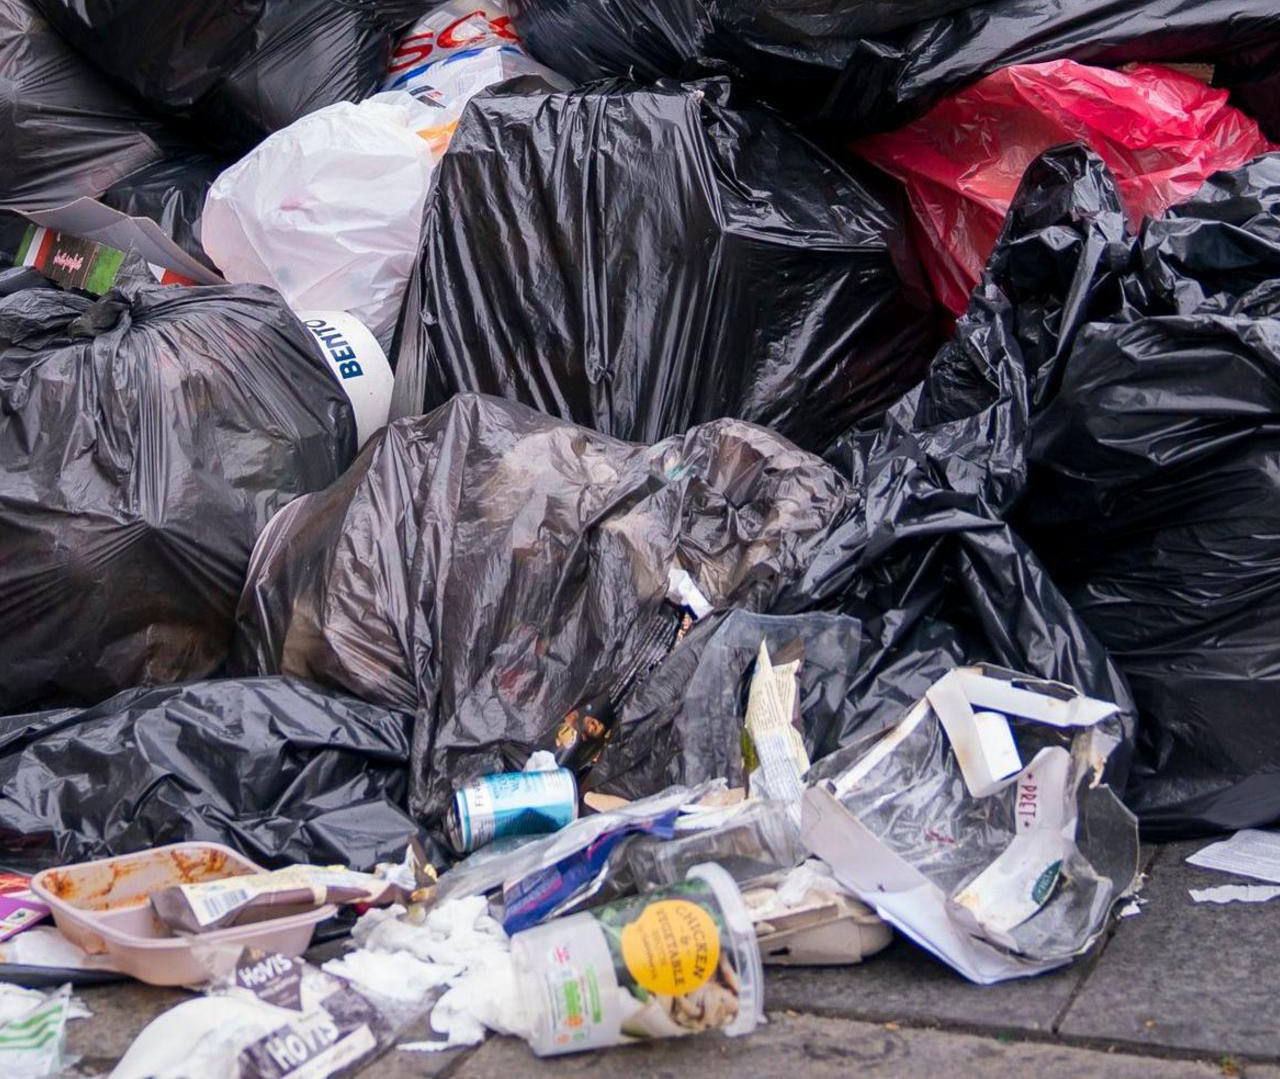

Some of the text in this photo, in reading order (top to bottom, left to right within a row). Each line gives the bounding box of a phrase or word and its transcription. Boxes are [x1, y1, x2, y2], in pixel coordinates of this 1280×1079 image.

[303, 319, 364, 380] BENTO
[1018, 785, 1038, 818] PRET
[238, 953, 293, 988] HOVIS
[656, 907, 685, 987] VEGETABLE
[675, 905, 708, 980] CHICKEN
